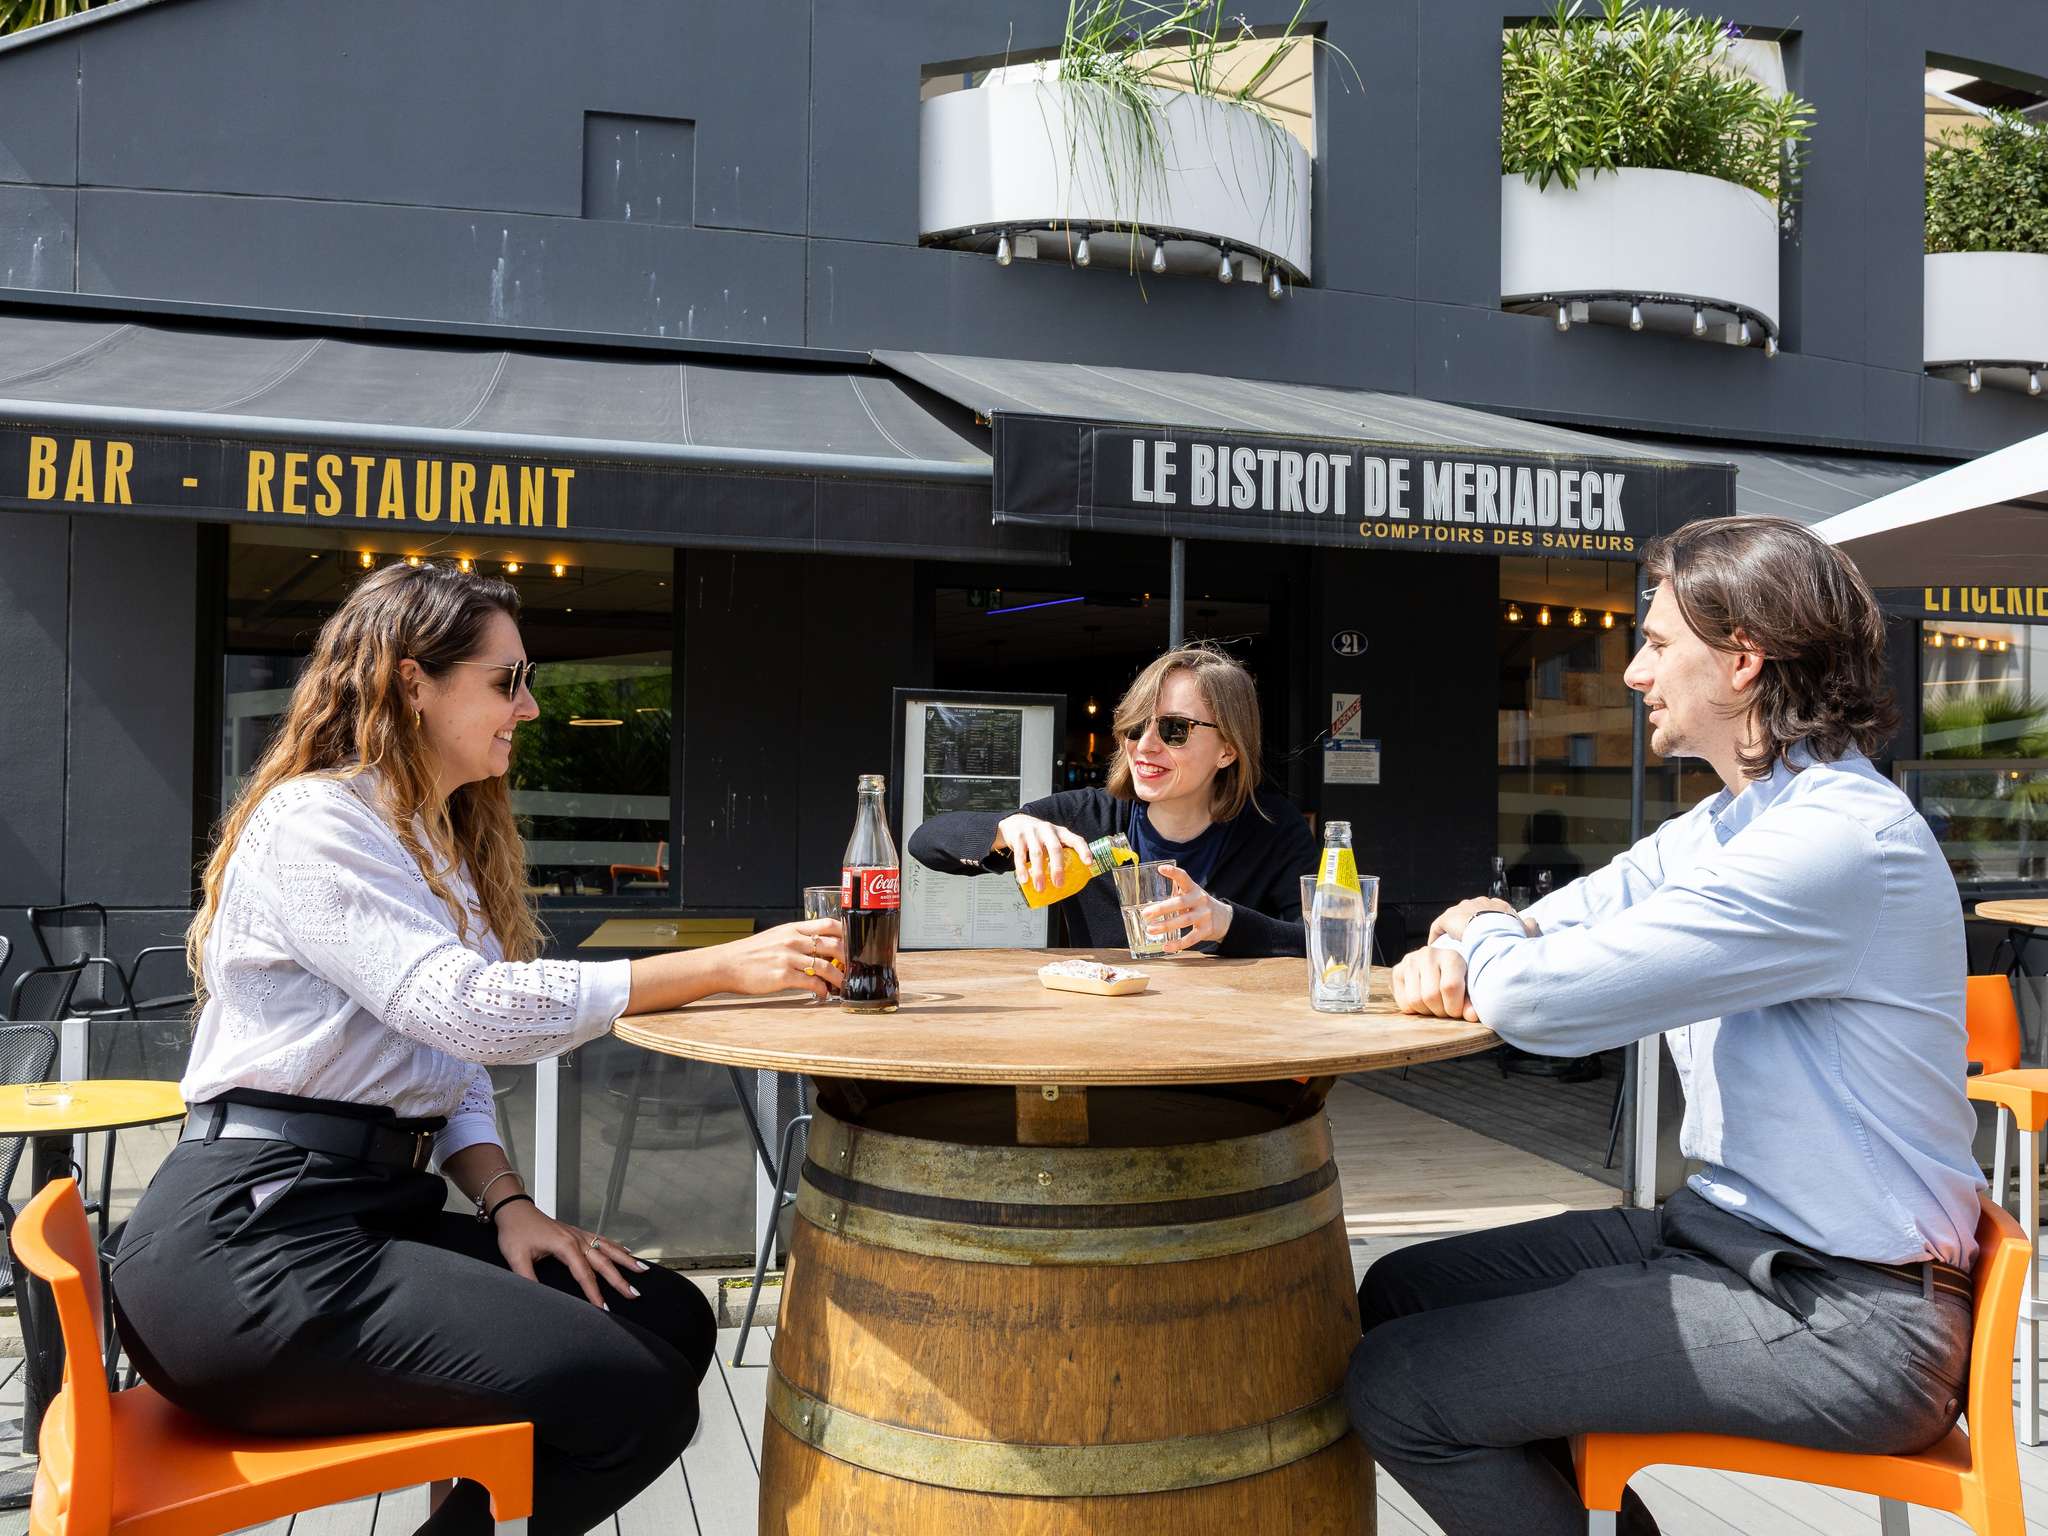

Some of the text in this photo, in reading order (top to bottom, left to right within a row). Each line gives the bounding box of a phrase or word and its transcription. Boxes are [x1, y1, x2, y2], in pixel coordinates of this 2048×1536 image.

[27, 436, 576, 529] BAR - RESTAURANT
[1132, 439, 1626, 532] LE BISTROT DE MERIADECK
[1359, 521, 1635, 552] COMPTOIRS DES SAVEURS
[1341, 634, 1359, 653] 21
